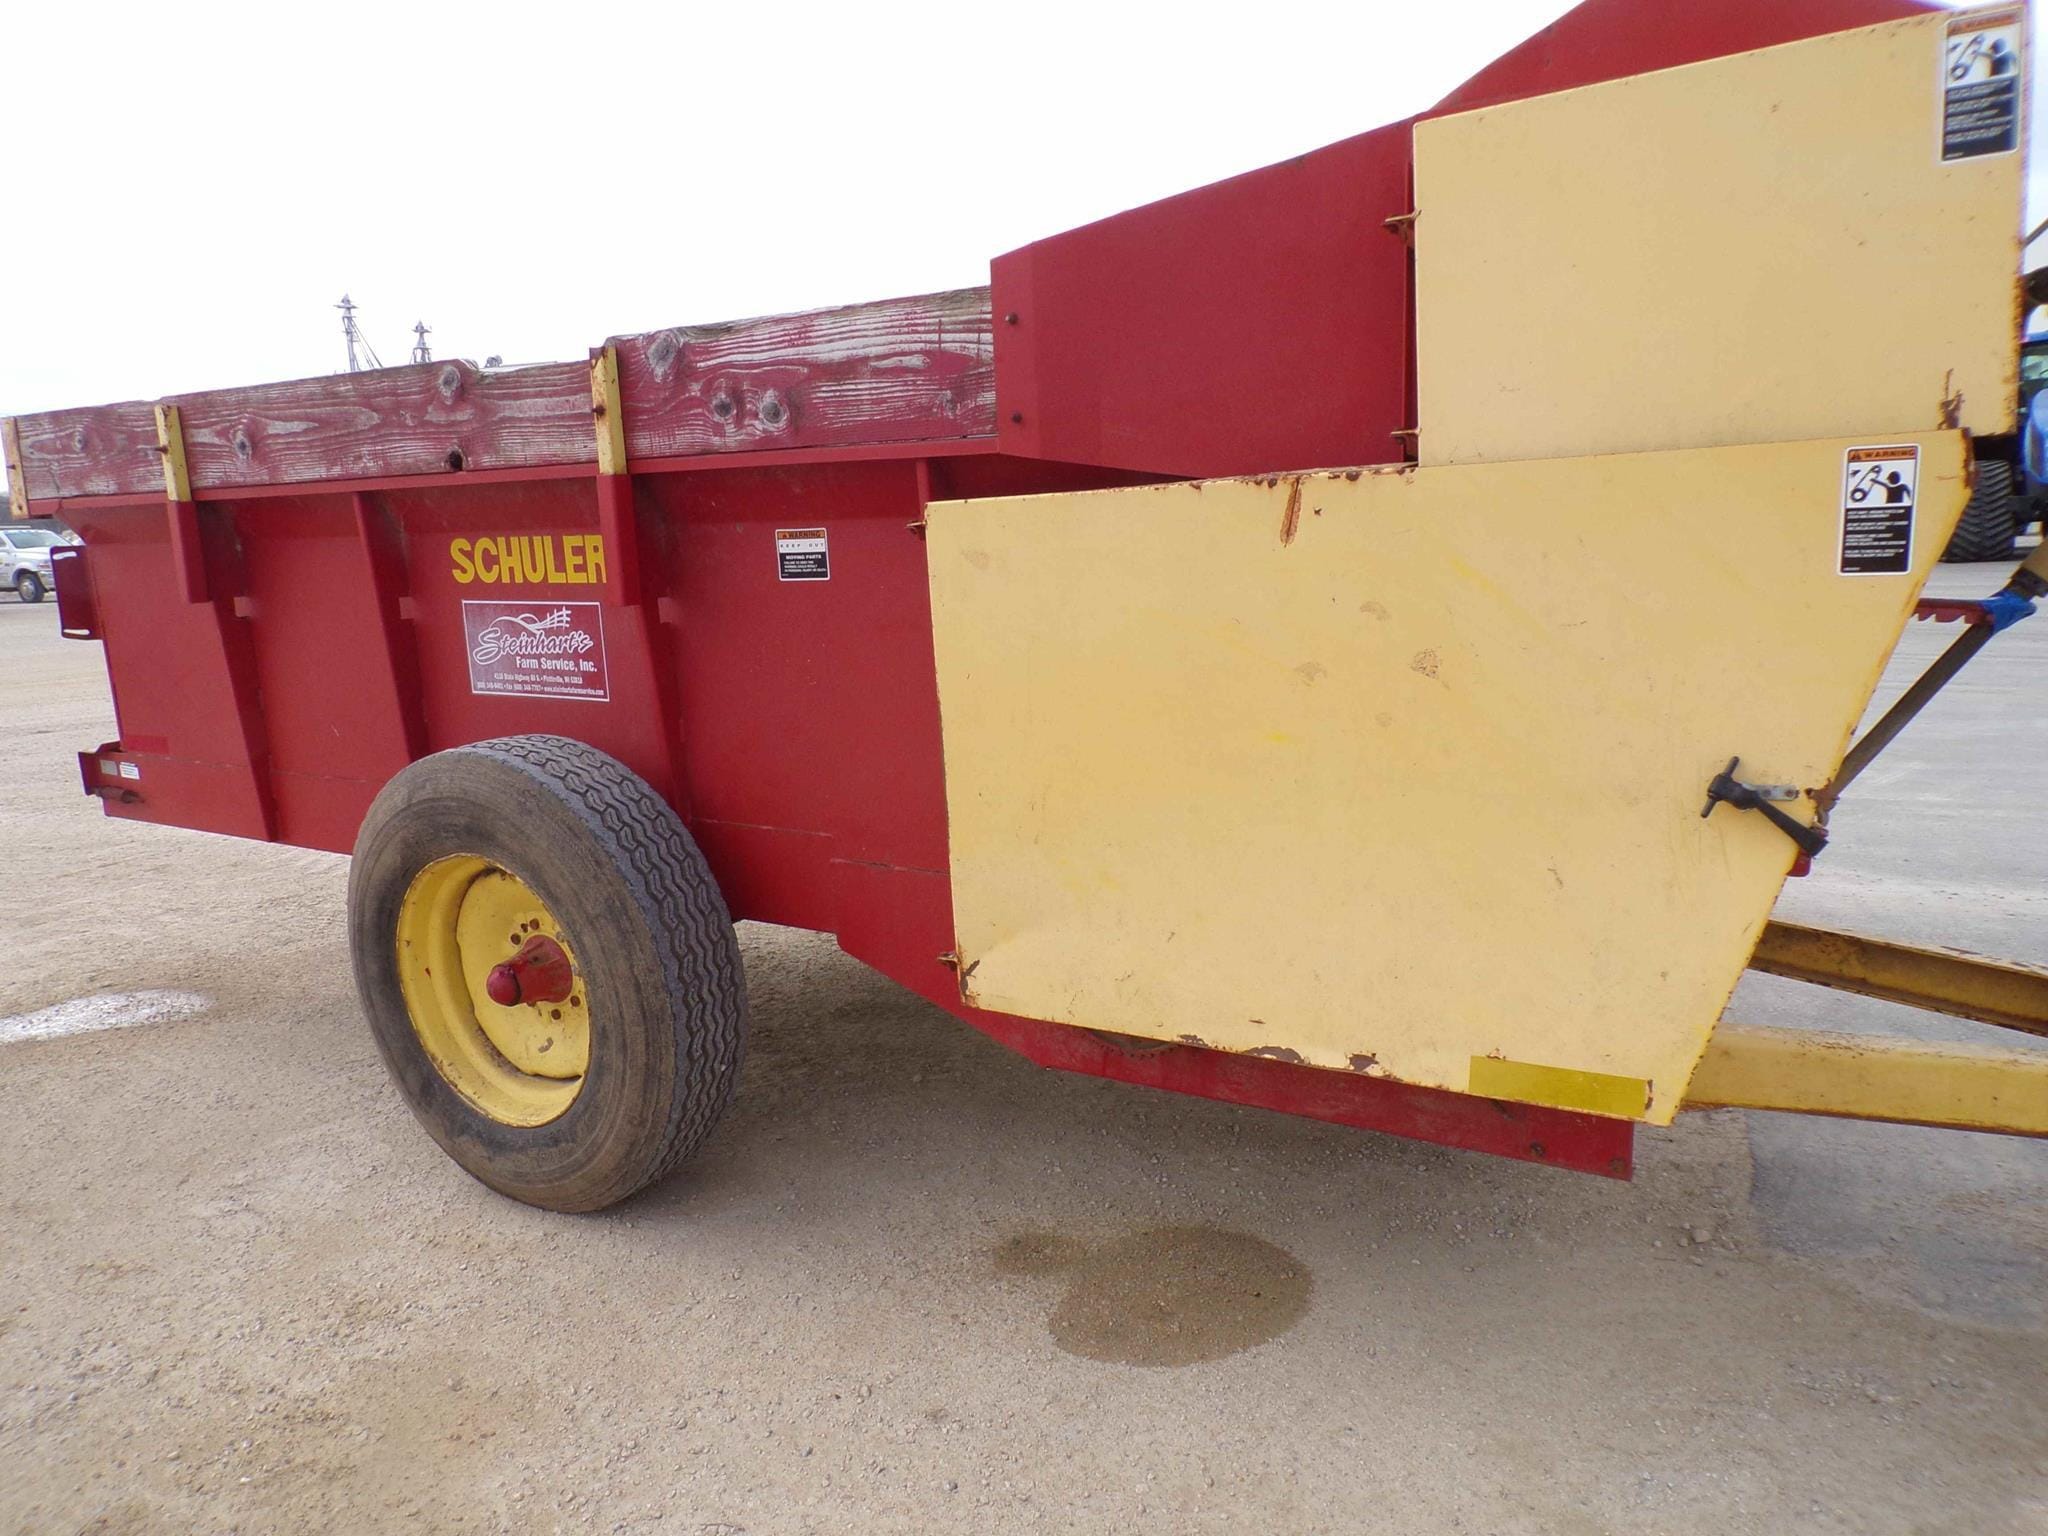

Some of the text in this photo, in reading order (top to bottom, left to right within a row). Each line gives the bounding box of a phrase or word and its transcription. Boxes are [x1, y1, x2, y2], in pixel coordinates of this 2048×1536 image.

[1864, 450, 1915, 458] WARNING
[450, 535, 607, 584] SCHULER
[473, 627, 593, 665] Steinhart's
[516, 656, 597, 672] Farm Service, Inc.
